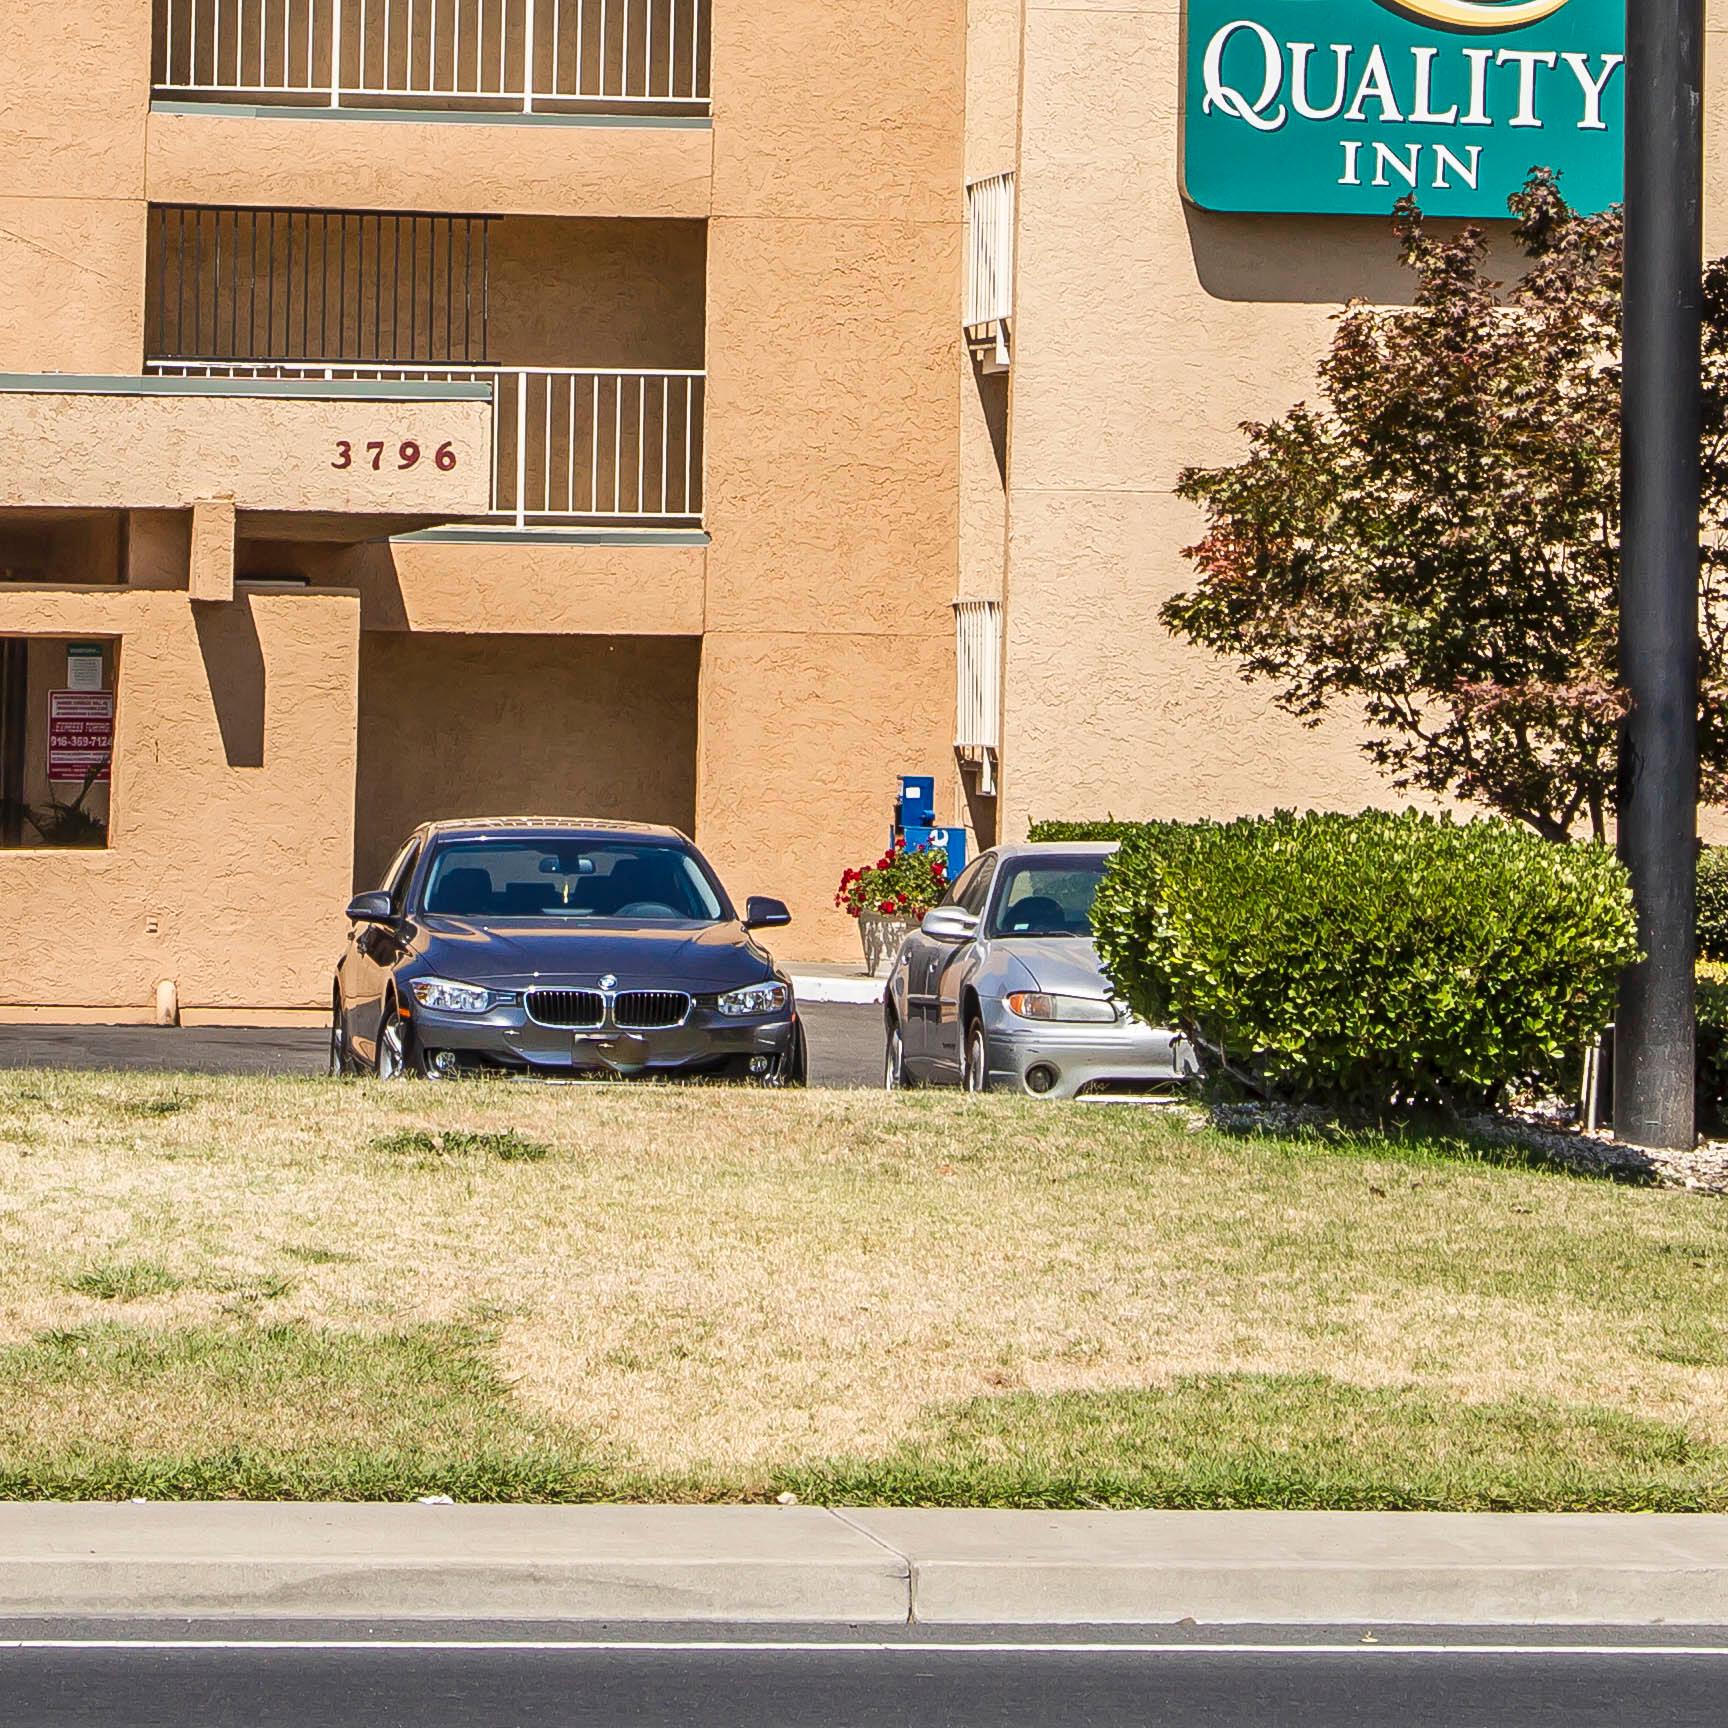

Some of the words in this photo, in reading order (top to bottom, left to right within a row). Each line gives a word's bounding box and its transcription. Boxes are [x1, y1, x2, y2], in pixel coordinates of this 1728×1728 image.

[1202, 19, 1624, 131] QUALITY
[1337, 141, 1483, 190] INN
[331, 440, 457, 471] 3796
